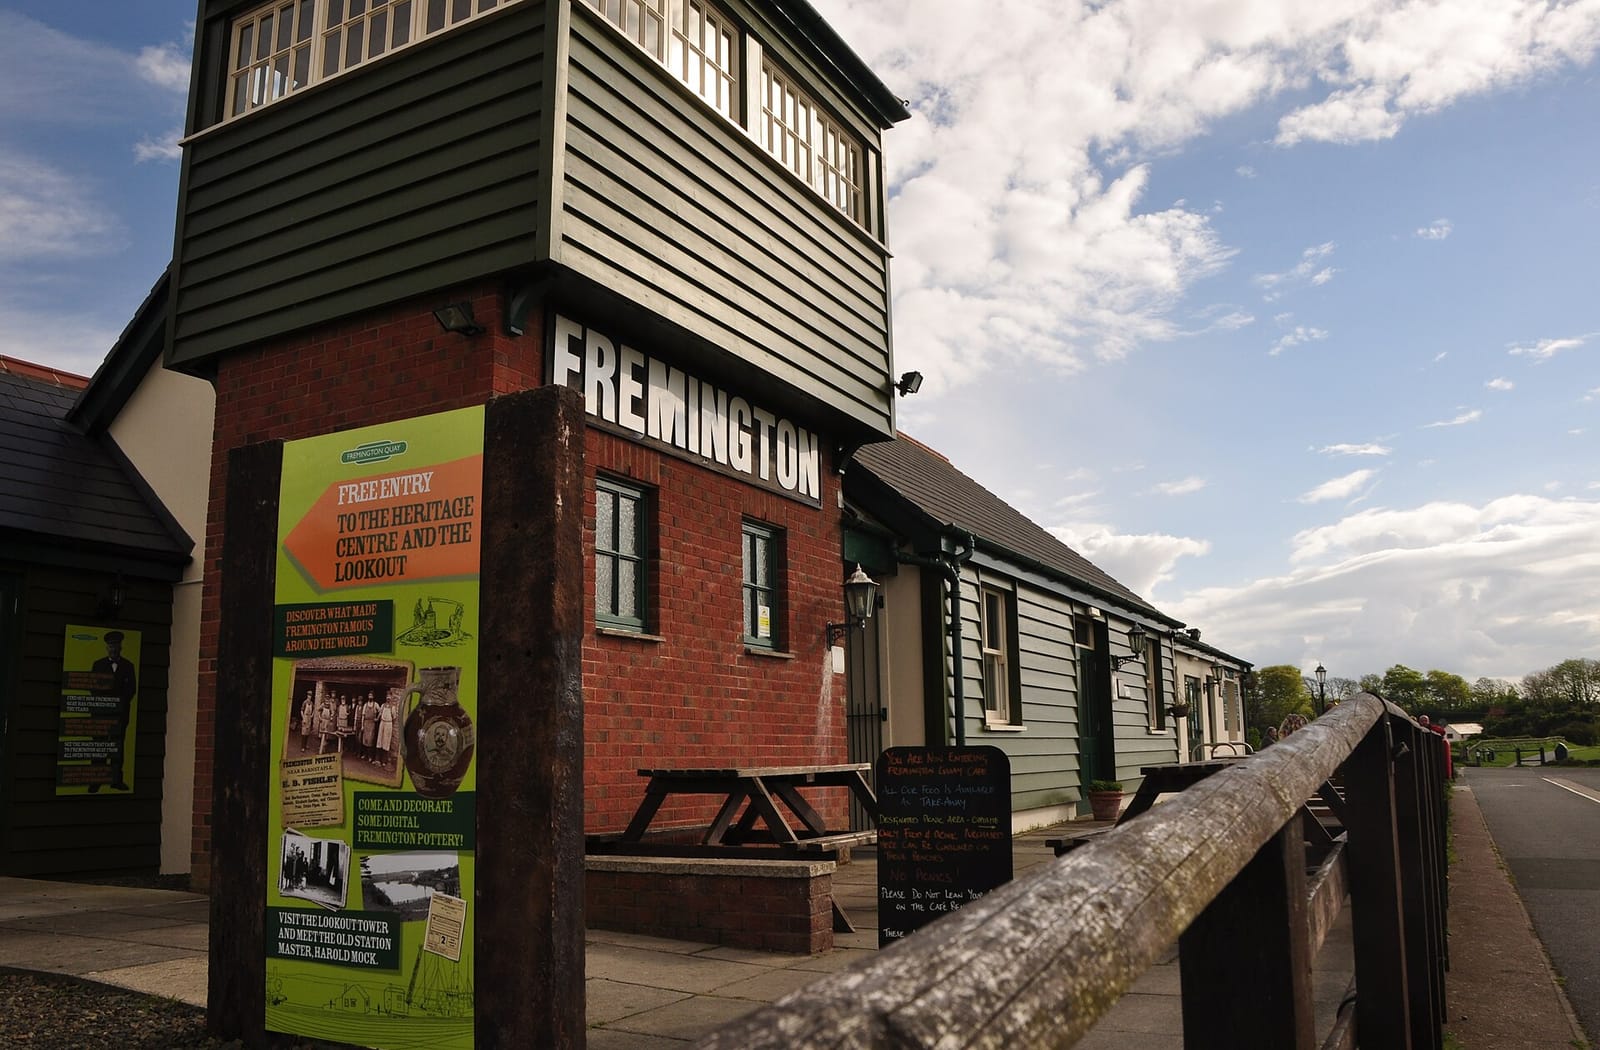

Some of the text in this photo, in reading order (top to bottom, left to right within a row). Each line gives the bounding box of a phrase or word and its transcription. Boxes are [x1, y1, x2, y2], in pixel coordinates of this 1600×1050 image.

[553, 313, 819, 500] FREMINGTON
[384, 444, 401, 454] QUAY
[337, 471, 434, 506] FREE ENTRY
[337, 495, 475, 534] TO THE HERITAGE
[335, 522, 472, 558] CENTRE AND THE
[334, 555, 408, 582] LOOKOUT
[286, 603, 377, 622] DISCOVER WHAT MADE
[285, 619, 374, 637] FREMINGTON FAMOUS
[285, 635, 368, 652] AROUND THE WORLD
[358, 798, 453, 813] COME AND DECORATE
[357, 815, 420, 829] SOME DIGITAL
[357, 830, 464, 847] FREMINGTON POTTERY!
[278, 911, 389, 934] VISIT THE LOOKOUT TOWER
[278, 927, 392, 951] AND MEET THE OLD STATION
[440, 935, 447, 945] 2
[278, 942, 379, 966] MASTER, HAROLD MOCK.
